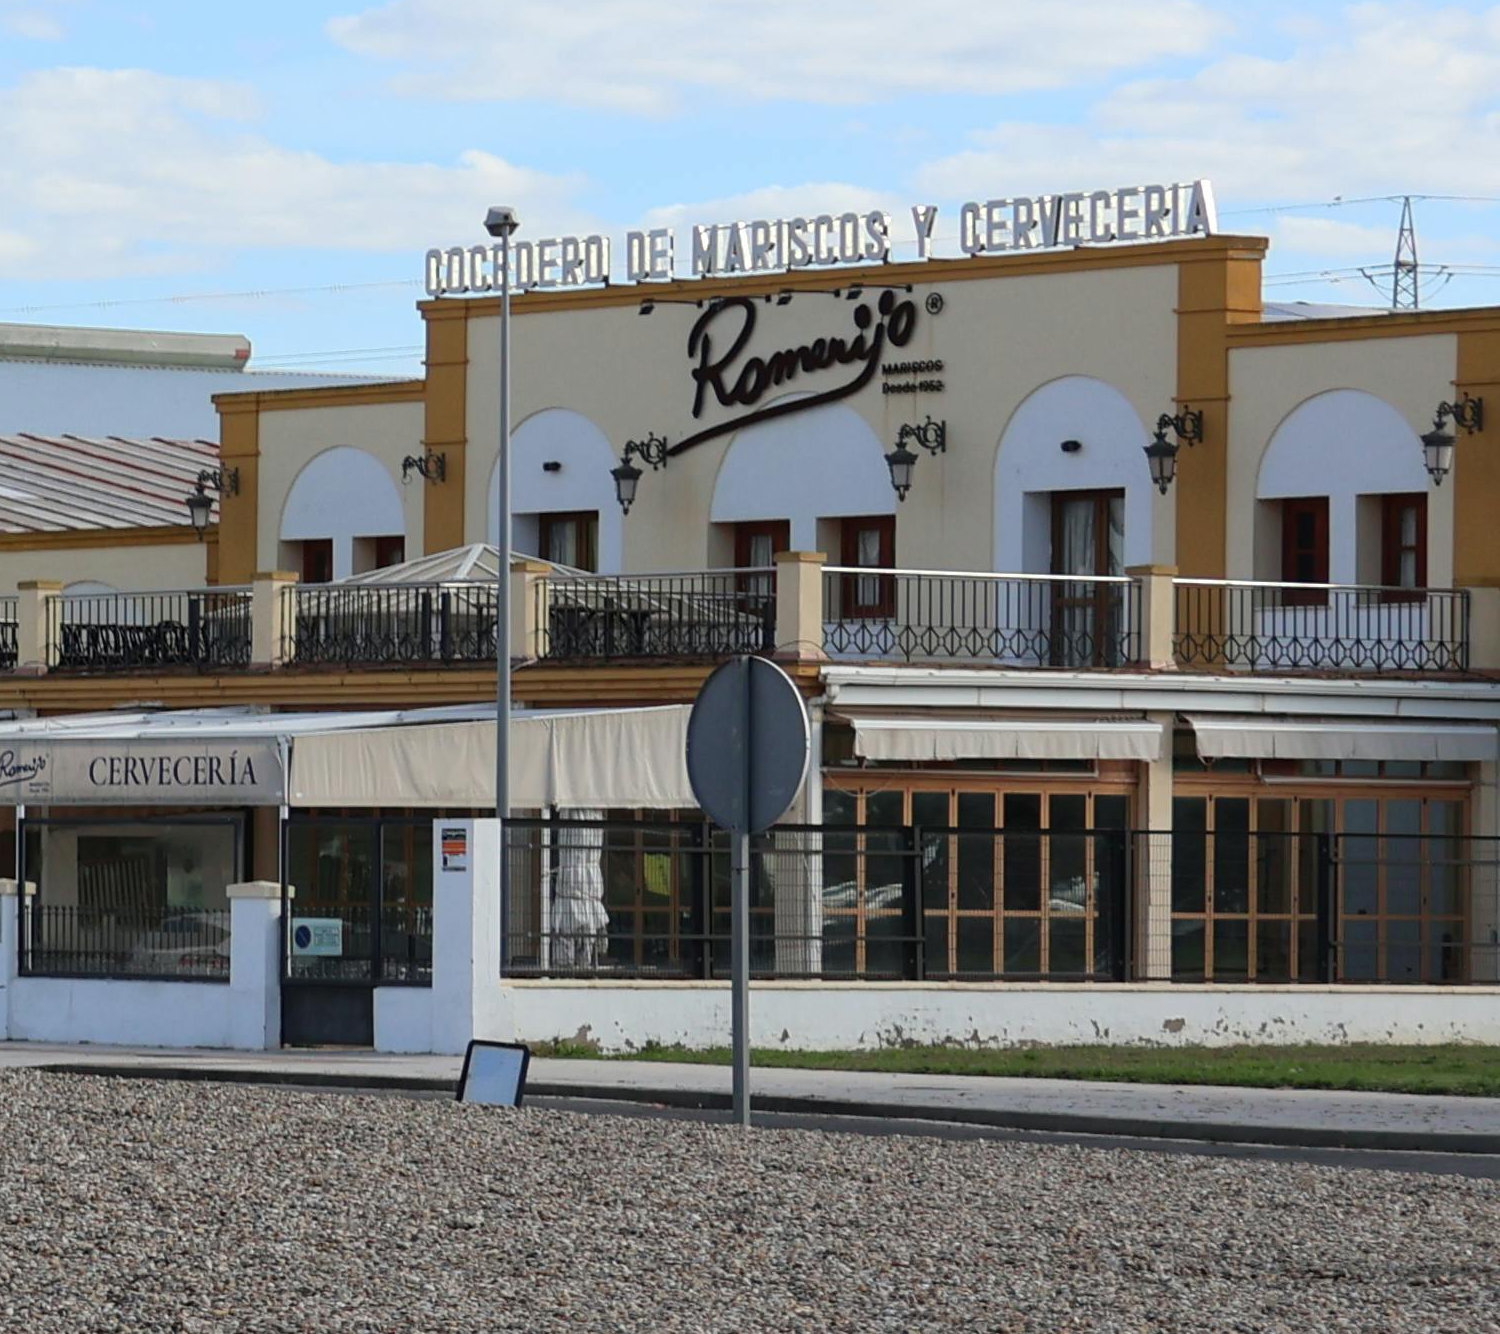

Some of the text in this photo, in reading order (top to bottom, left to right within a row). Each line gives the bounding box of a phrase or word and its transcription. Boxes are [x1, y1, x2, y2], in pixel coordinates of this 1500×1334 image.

[627, 228, 674, 281] DE
[692, 210, 890, 275] MARISCOS
[912, 205, 937, 258] Y
[960, 180, 1217, 255] CERVECERIA
[667, 290, 915, 456] Romerijo
[882, 360, 943, 375] MARISCOS
[882, 380, 943, 395] Desde 1952
[89, 749, 258, 786] CERVECERÍA
